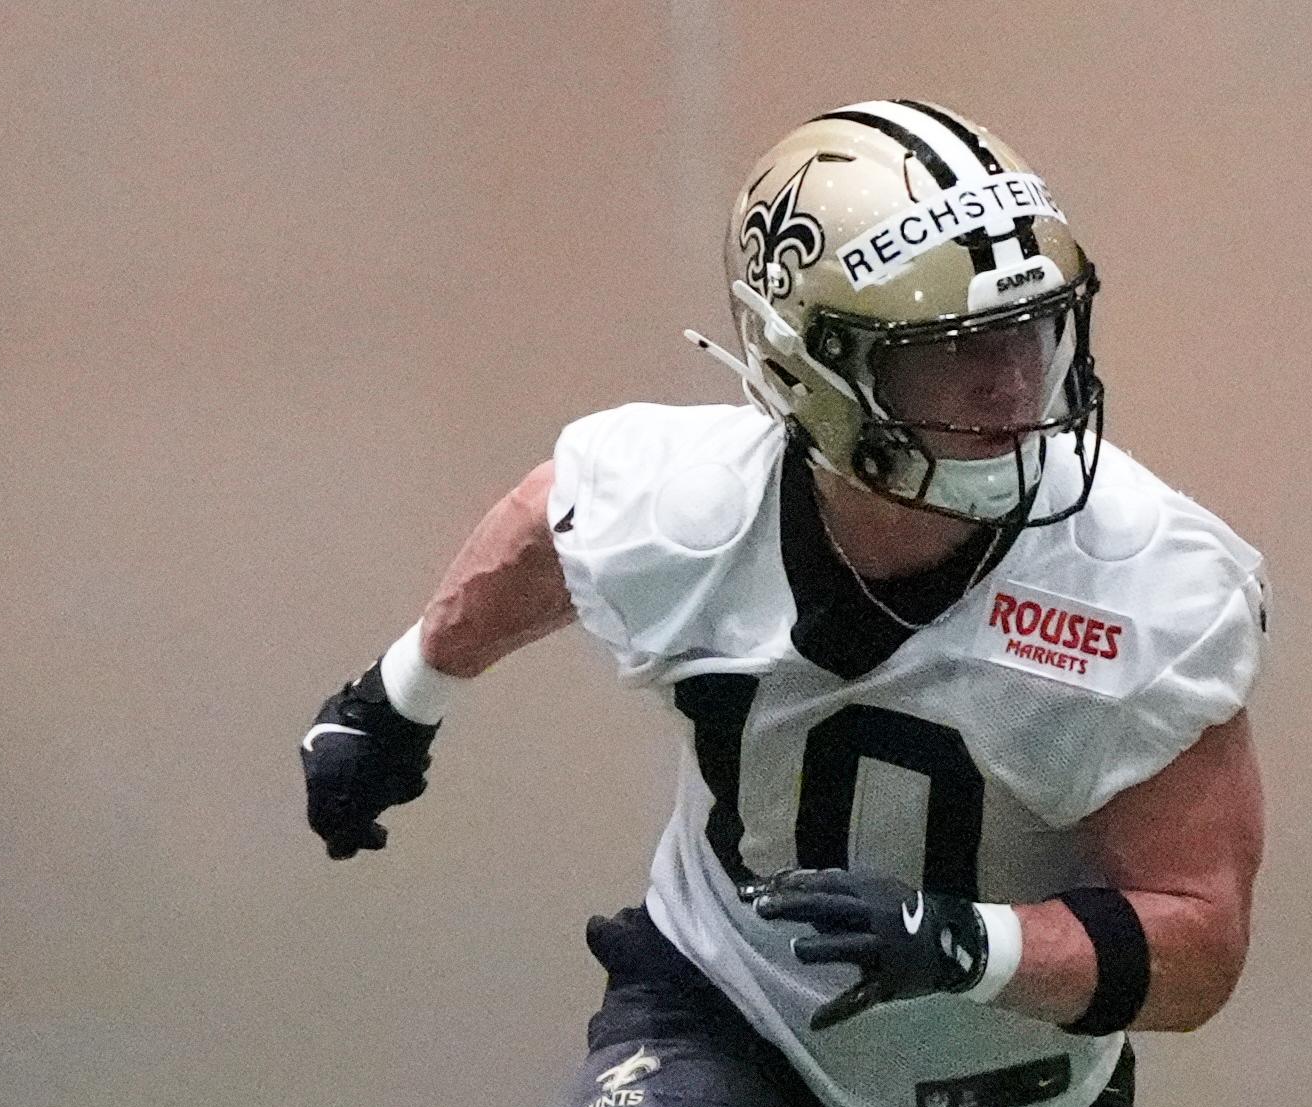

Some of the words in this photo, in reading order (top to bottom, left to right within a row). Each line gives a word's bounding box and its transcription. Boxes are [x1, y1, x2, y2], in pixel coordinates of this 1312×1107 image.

[989, 592, 1122, 660] ROUSES
[1005, 639, 1089, 675] MARKETS
[674, 672, 985, 903] 10
